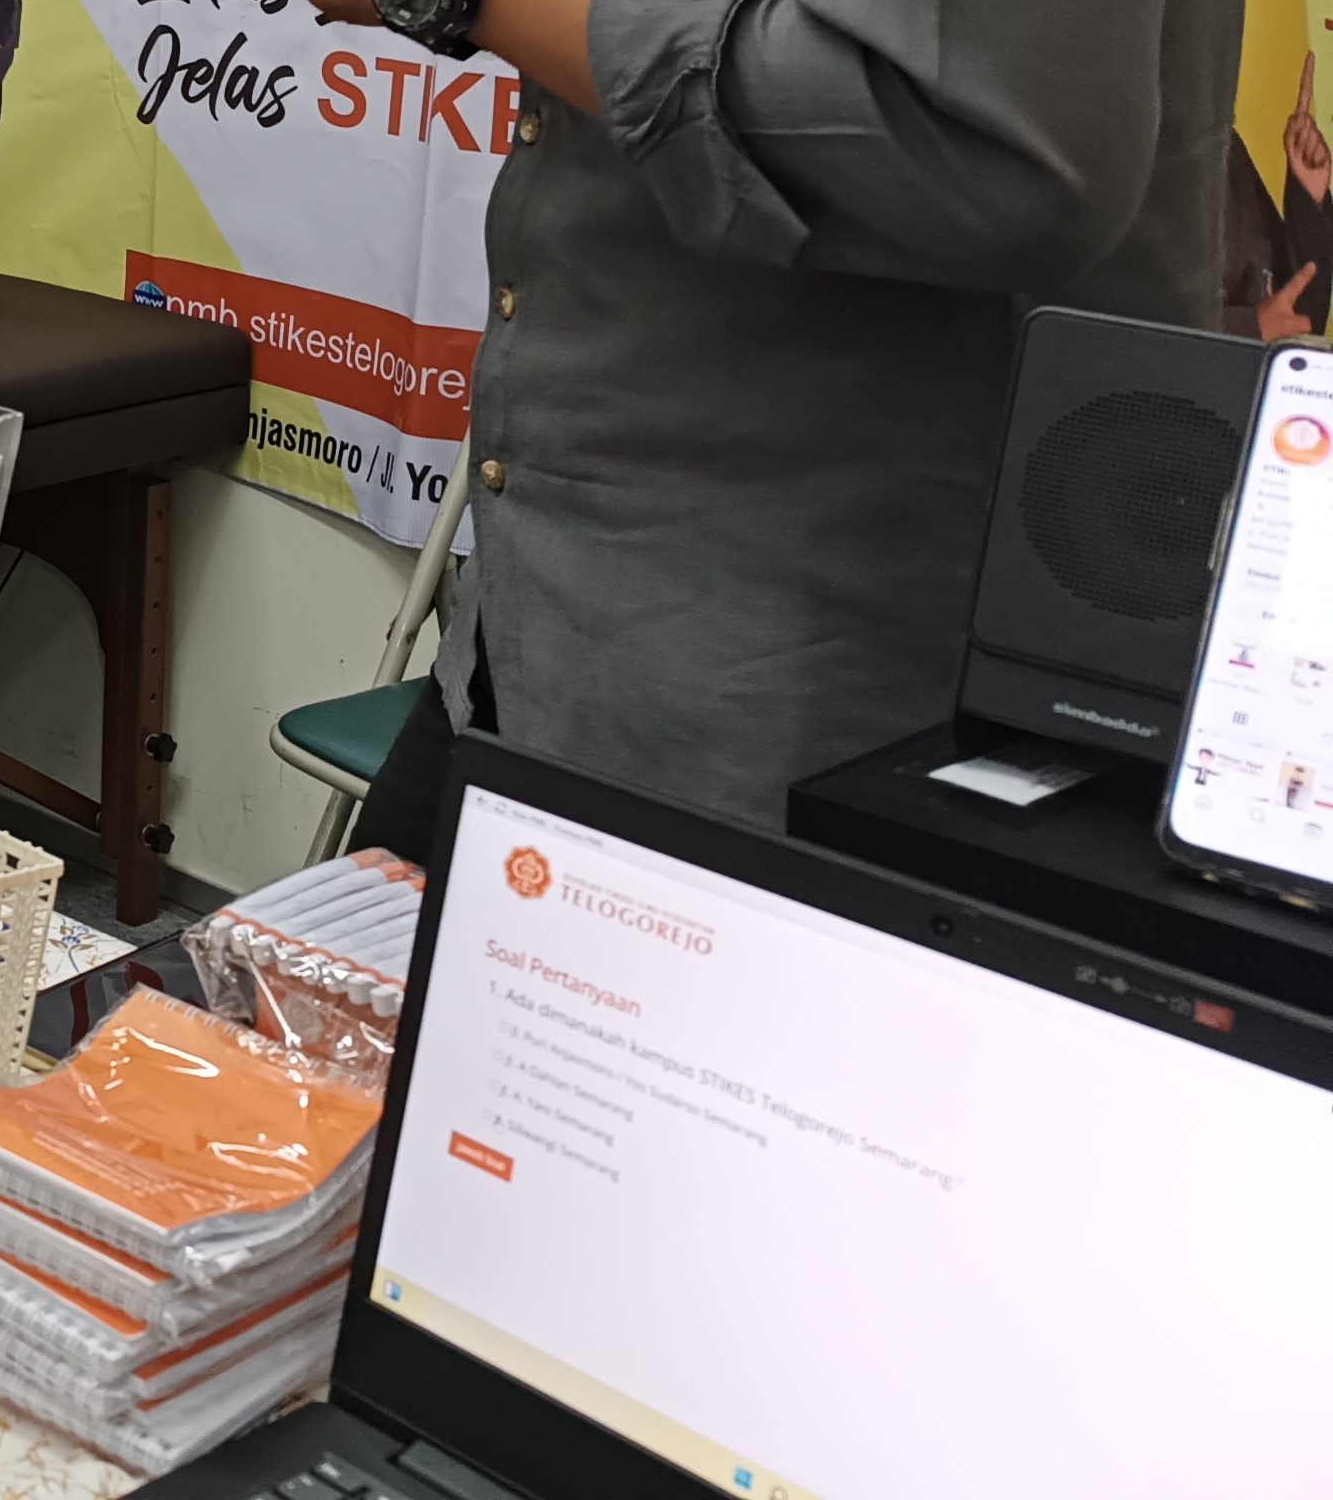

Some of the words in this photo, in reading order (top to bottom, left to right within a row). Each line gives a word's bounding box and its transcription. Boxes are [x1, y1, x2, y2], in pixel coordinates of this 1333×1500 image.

[136, 25, 298, 128] Jelas
[561, 883, 714, 956] TELOGOREJO
[485, 938, 527, 971] Soal
[530, 956, 642, 1019] Pertanyaan
